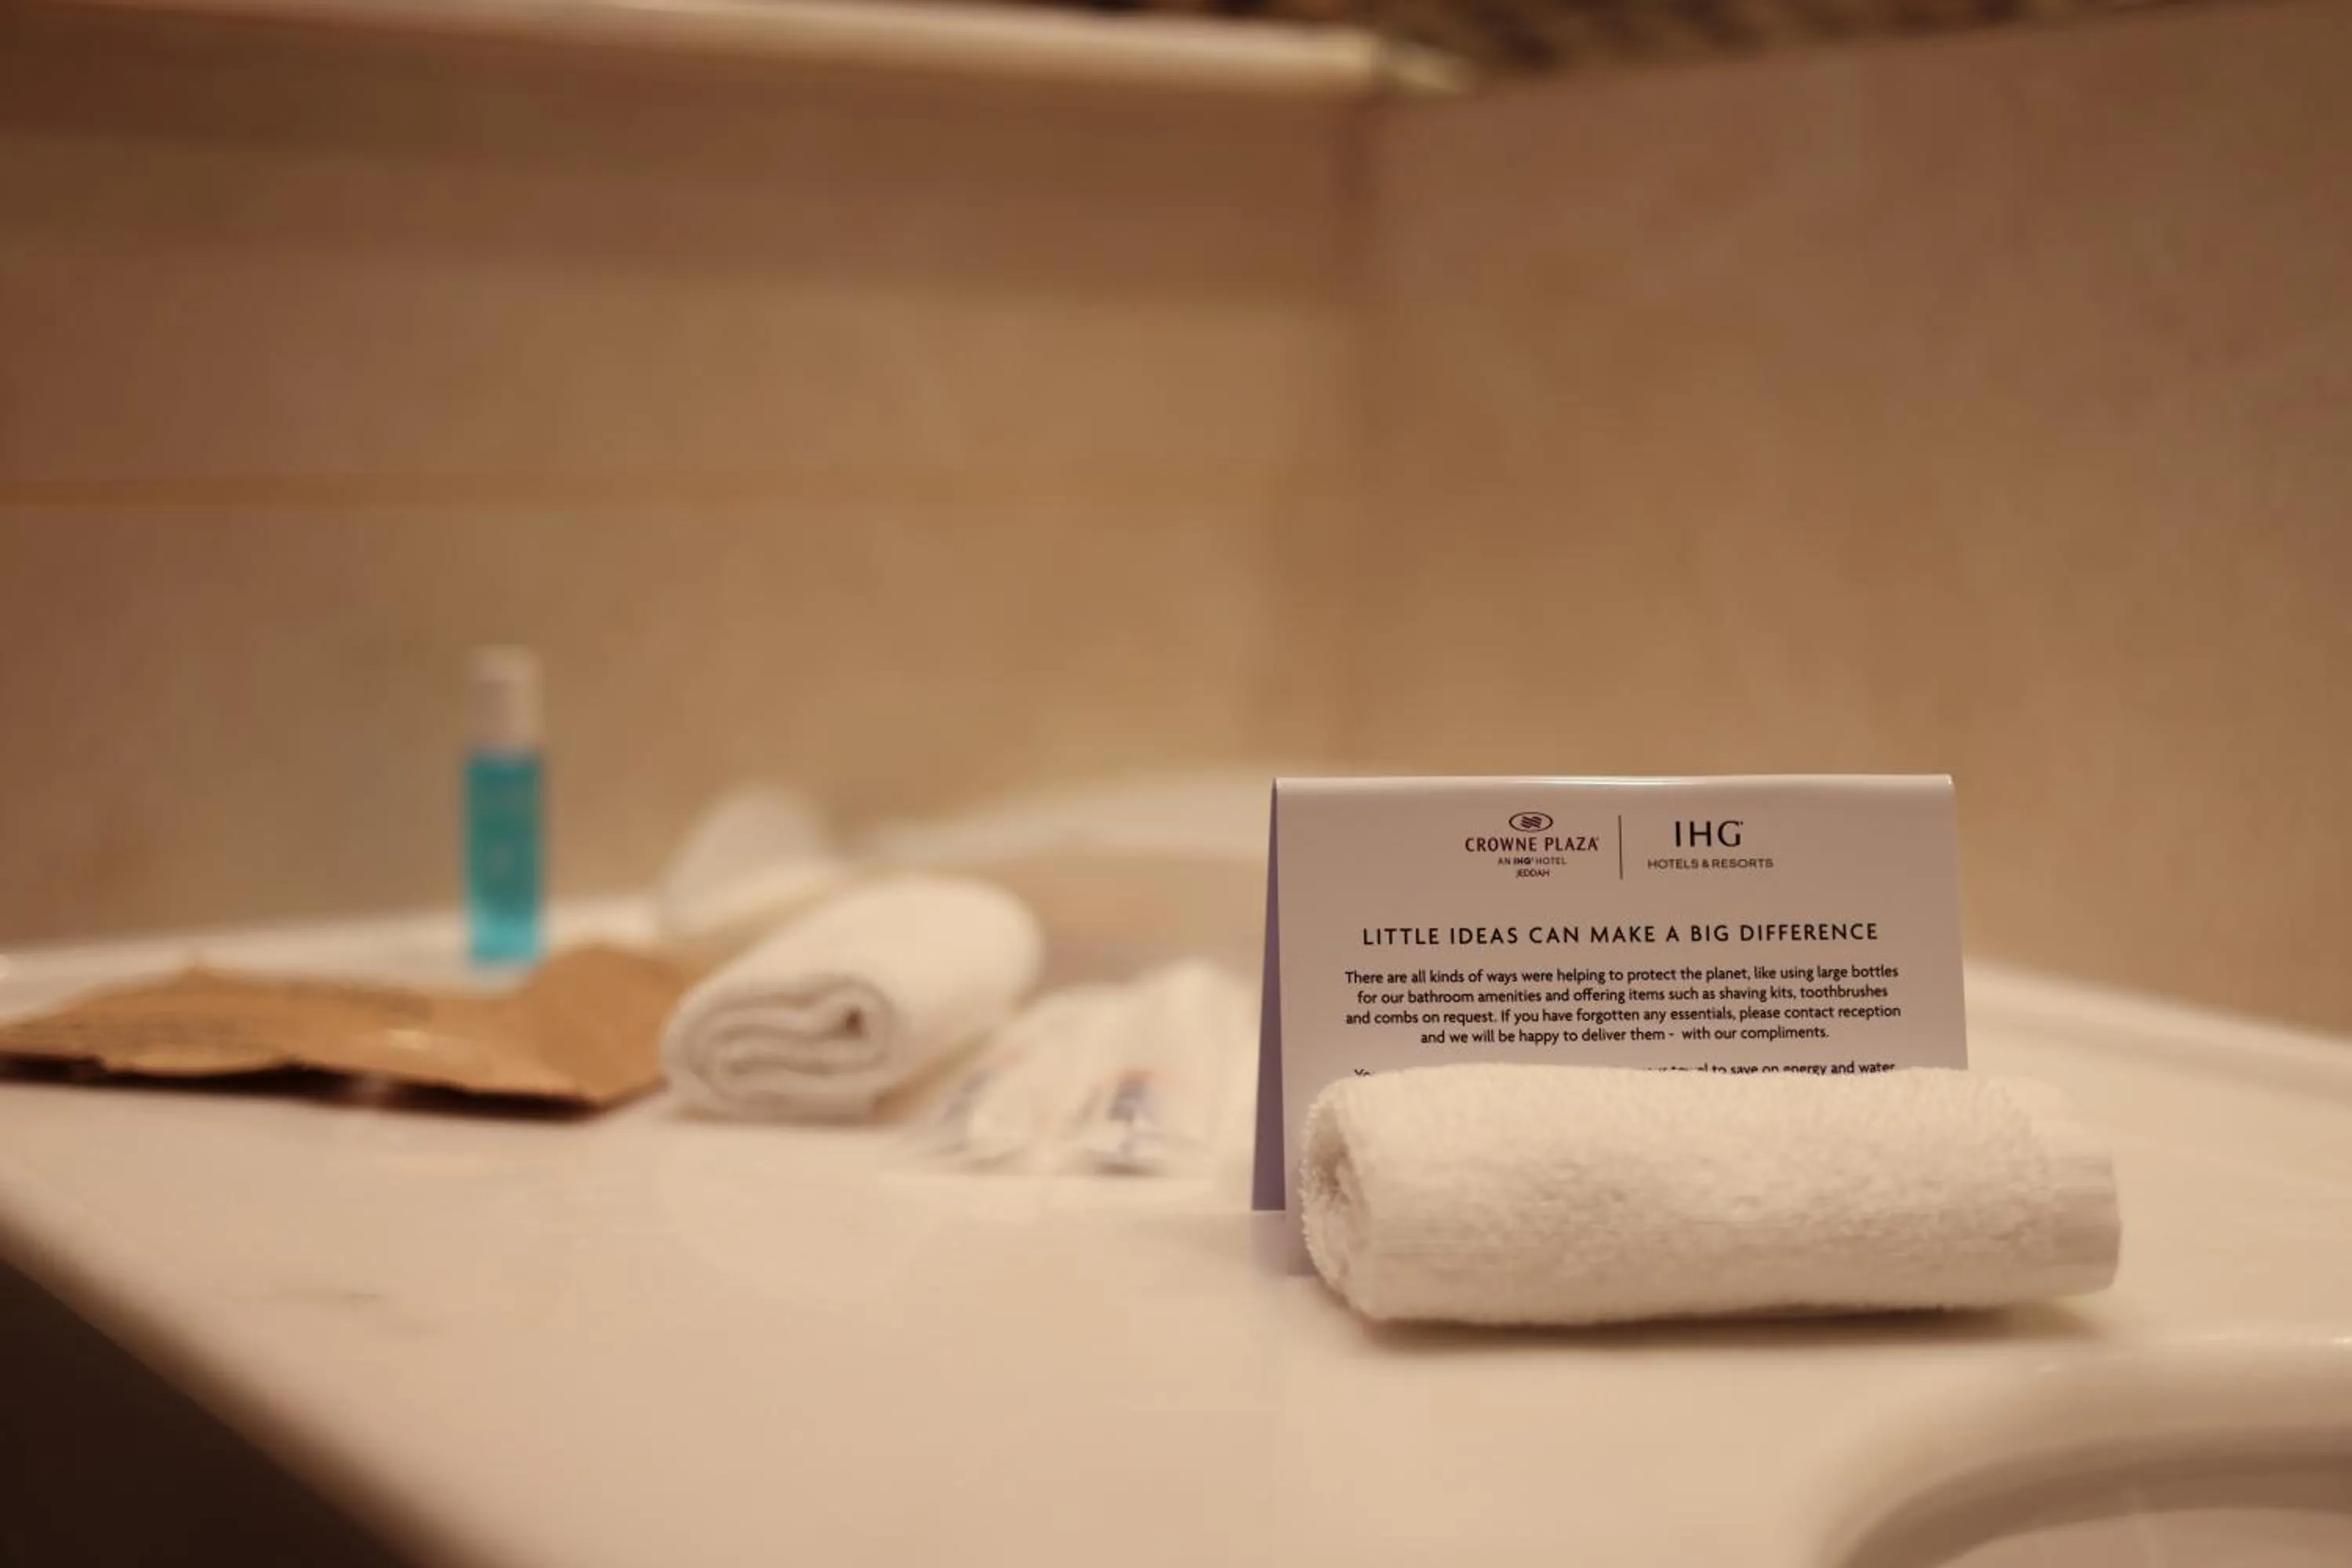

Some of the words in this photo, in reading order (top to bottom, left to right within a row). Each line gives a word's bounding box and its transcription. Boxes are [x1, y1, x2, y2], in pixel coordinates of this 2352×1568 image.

[1465, 836, 1537, 853] CROWNE
[1544, 836, 1600, 852] PLAZA
[1674, 819, 1744, 848] IHG
[1515, 868, 1551, 879] JEDDAH
[1647, 858, 1700, 870] HOTELS
[1701, 858, 1710, 869] &
[1711, 858, 1774, 869] RESORTS
[1363, 927, 1440, 946] LITTLE
[1450, 926, 1519, 946] IDEAS
[1528, 925, 1580, 945] CAN
[1589, 925, 1657, 944] MAKE
[1665, 924, 1681, 943] A
[1690, 924, 1730, 943] BIG
[1739, 922, 1878, 942] DIFFERENCE
[1343, 969, 1385, 985] There
[1386, 972, 1408, 984] are
[1410, 968, 1427, 985] all
[1429, 968, 1465, 984] kinds
[1467, 968, 1484, 983] of
[1486, 971, 1519, 986] ways
[1520, 971, 1554, 983] were
[1555, 967, 1606, 985] helping
[1608, 969, 1624, 982] to
[1626, 968, 1678, 985] protect
[1679, 965, 1703, 981] the
[1705, 965, 1751, 985] planet,
[1753, 965, 1777, 980] like
[1779, 965, 1815, 983] using
[1816, 964, 1849, 982] large
[1850, 963, 1900, 978] bottles
[1356, 989, 1378, 1005] for
[1380, 993, 1406, 1005] our
[1407, 989, 1475, 1004] bathroom
[1477, 989, 1543, 1004] amenities
[1544, 987, 1571, 1003] and
[1573, 987, 1626, 1005] offering
[1628, 986, 1666, 1002] items
[1668, 985, 1700, 1001] such
[1701, 989, 1716, 1000] as
[1718, 985, 1768, 1004] shaving
[1769, 985, 1797, 1000] kits,
[1799, 983, 1889, 999] toothbrushes
[1344, 1009, 1371, 1025] and
[1373, 1009, 1420, 1025] combs
[1421, 1013, 1441, 1024] on
[1443, 1011, 1497, 1027] request.
[1500, 1008, 1512, 1023] If
[1513, 1011, 1540, 1027] you
[1541, 1007, 1573, 1022] have
[1575, 1007, 1640, 1025] forgotten
[1642, 1010, 1668, 1025] any
[1669, 1005, 1737, 1022] essentials,
[1739, 1004, 1781, 1024] please
[1783, 1006, 1835, 1019] contact
[1837, 1004, 1902, 1022] reception
[1420, 1029, 1446, 1044] and
[1448, 1033, 1469, 1044] we
[1471, 1028, 1496, 1044] will
[1497, 1028, 1516, 1044] be
[1518, 1028, 1560, 1047] happy
[1562, 1029, 1579, 1042] to
[1581, 1027, 1628, 1042] deliver
[1629, 1026, 1666, 1042] them
[1680, 1025, 1711, 1041] with
[1713, 1029, 1738, 1041] our
[1739, 1024, 1831, 1043] compliments.
[1730, 1065, 1759, 1074] save
[1762, 1065, 1779, 1073] on
[1782, 1065, 1828, 1076] energy
[1831, 1059, 1855, 1074] and
[1858, 1061, 1896, 1073] water
